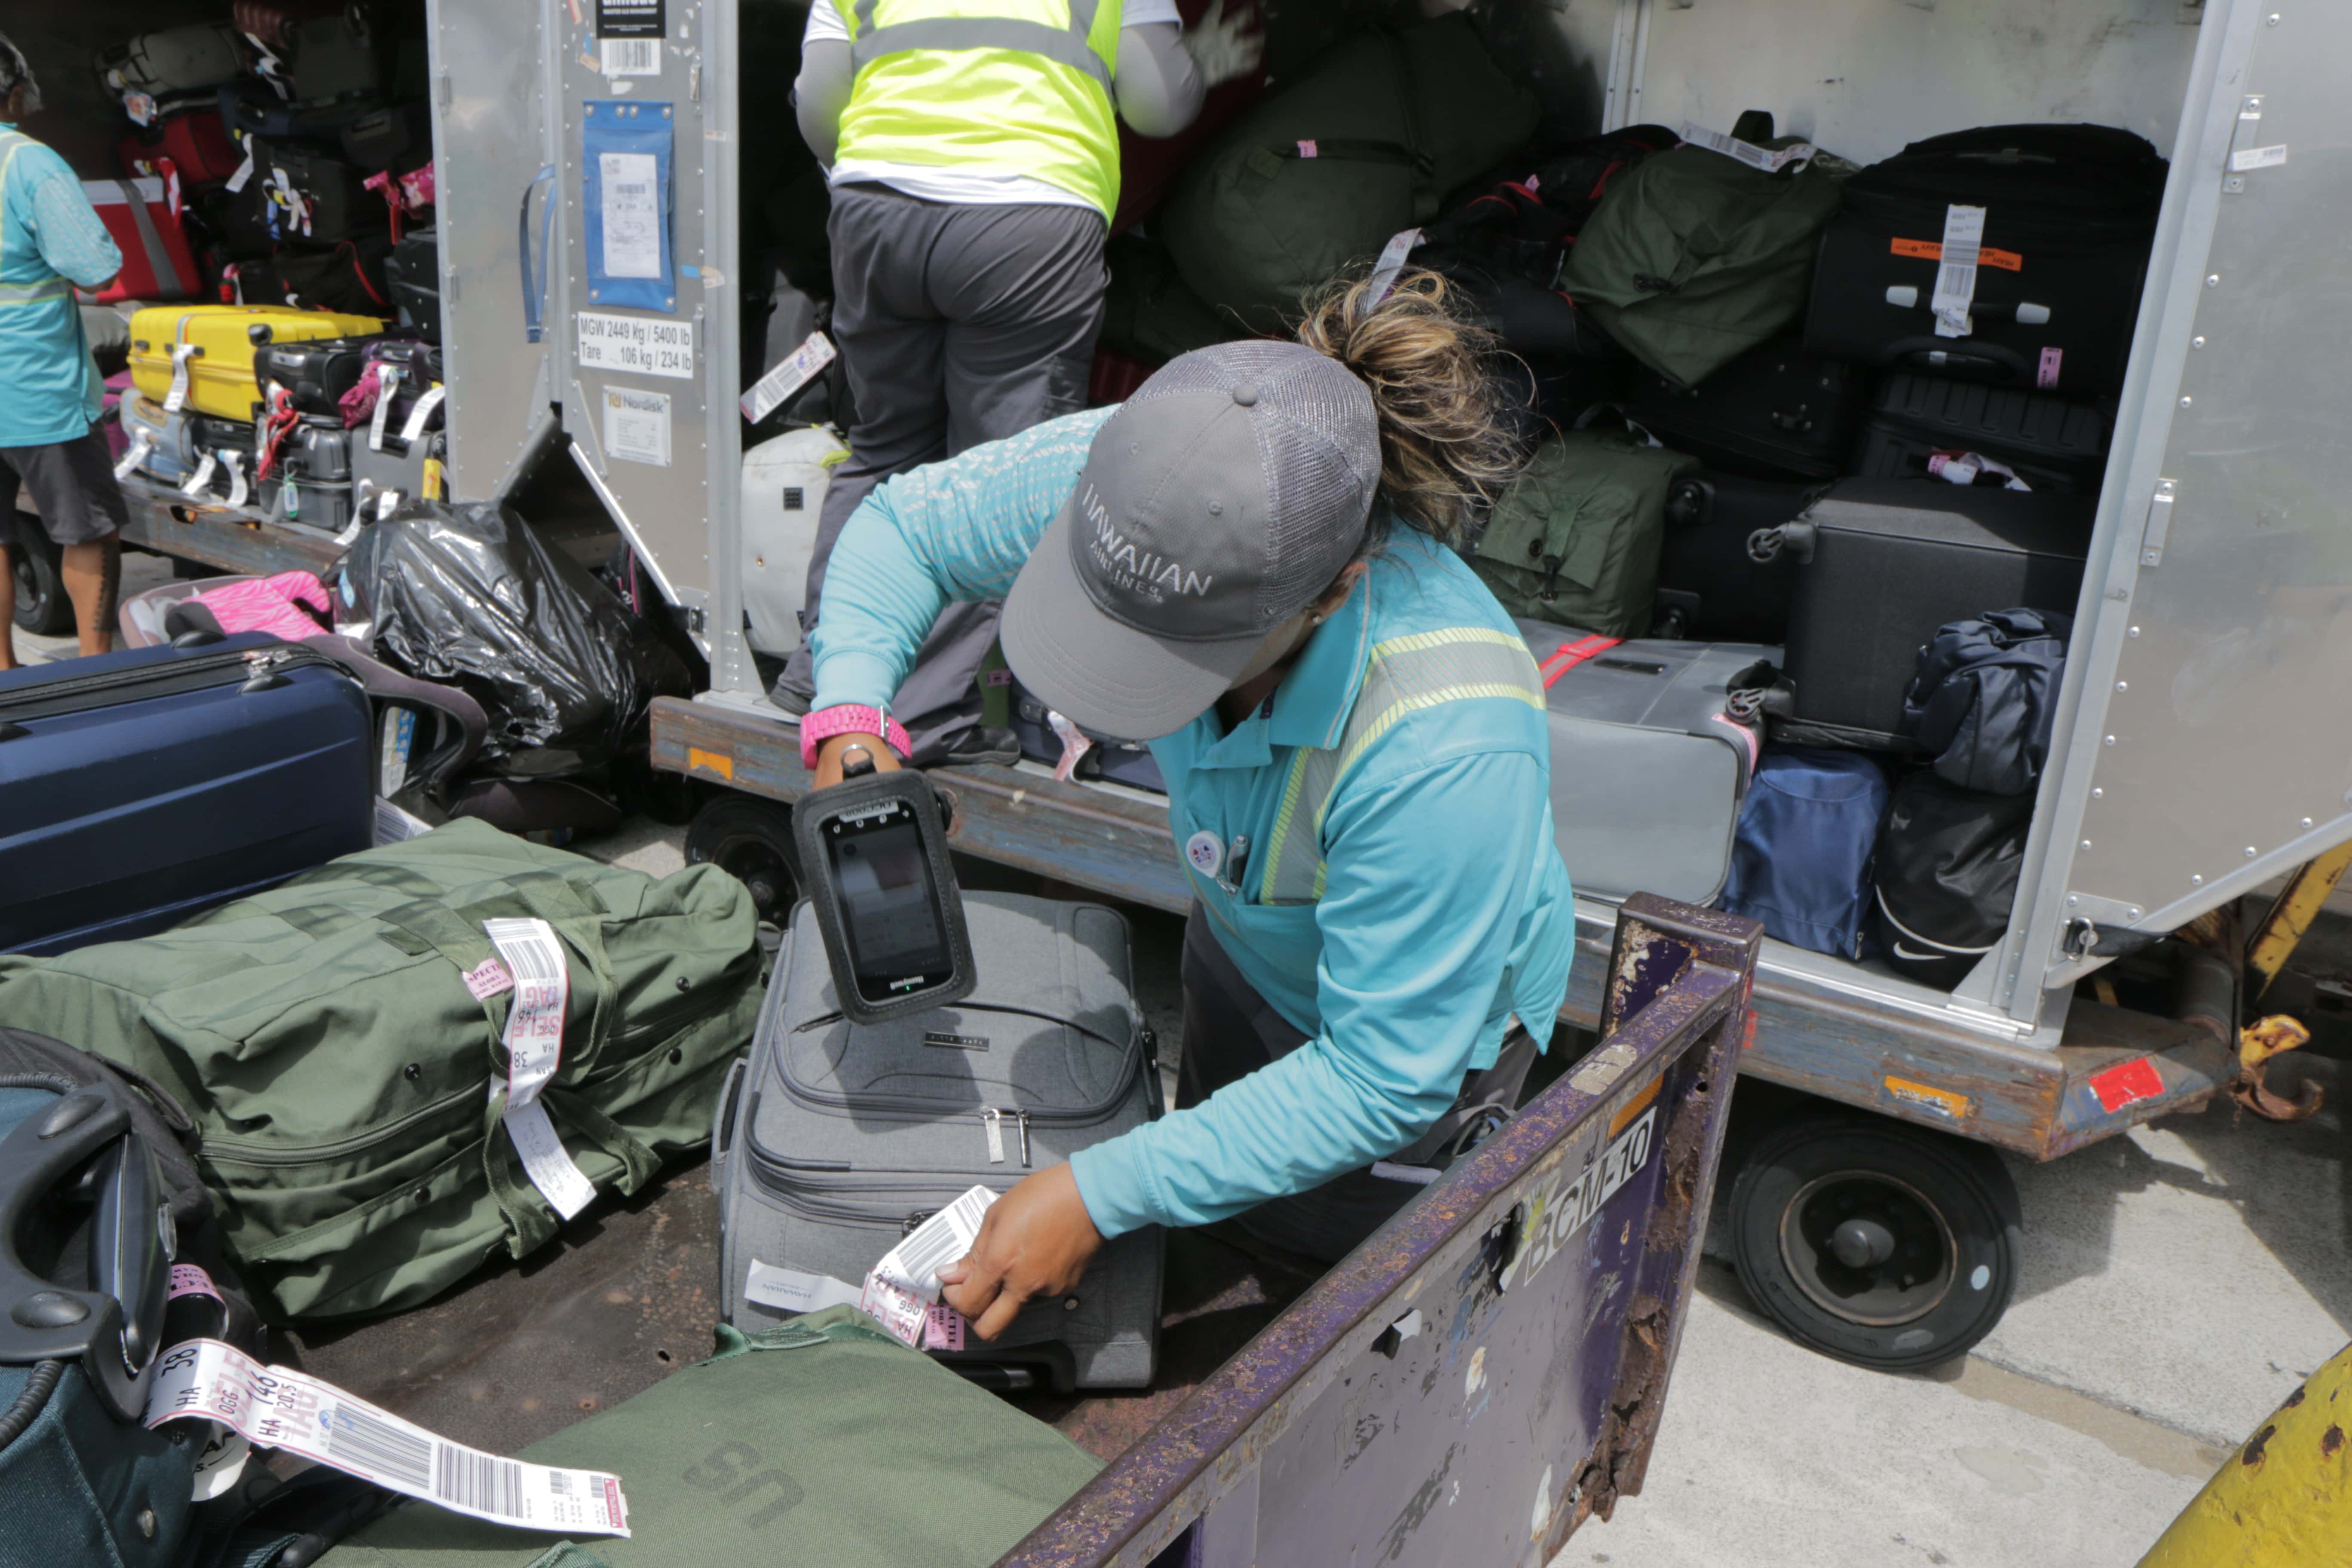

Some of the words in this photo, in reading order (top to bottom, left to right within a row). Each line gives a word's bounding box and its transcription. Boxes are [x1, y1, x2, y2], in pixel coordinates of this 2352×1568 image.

[581, 318, 604, 336] MGW
[608, 321, 630, 339] 2449
[633, 323, 645, 345] kg
[647, 325, 651, 342] /
[653, 325, 677, 344] 5400
[680, 328, 690, 346] lb
[581, 342, 601, 360] Tare
[621, 346, 637, 364] 106
[640, 349, 652, 370] kg
[655, 350, 658, 367] /
[661, 351, 679, 369] 234
[682, 353, 692, 371] lb
[623, 395, 664, 414] Nordisk
[1082, 483, 1213, 597] HAWAIIAN
[1090, 540, 1161, 599] AIRLINES
[513, 1015, 561, 1038] SELF
[539, 1025, 555, 1034] OGG
[514, 1051, 528, 1068] 38
[542, 1043, 554, 1053] HA
[536, 1066, 551, 1075] SAN
[1528, 1120, 1650, 1277] BCM-10
[763, 1283, 812, 1299] HAWAIIAN
[899, 1299, 920, 1316] OGG
[897, 1320, 913, 1336] HA
[160, 1348, 197, 1377] 38
[175, 1387, 202, 1407] HA
[209, 1349, 258, 1428] SELF
[245, 1371, 279, 1406] 146
[276, 1383, 297, 1409] 20.5
[218, 1389, 239, 1415] OGG
[268, 1387, 319, 1439] TAG
[258, 1419, 282, 1437] HA
